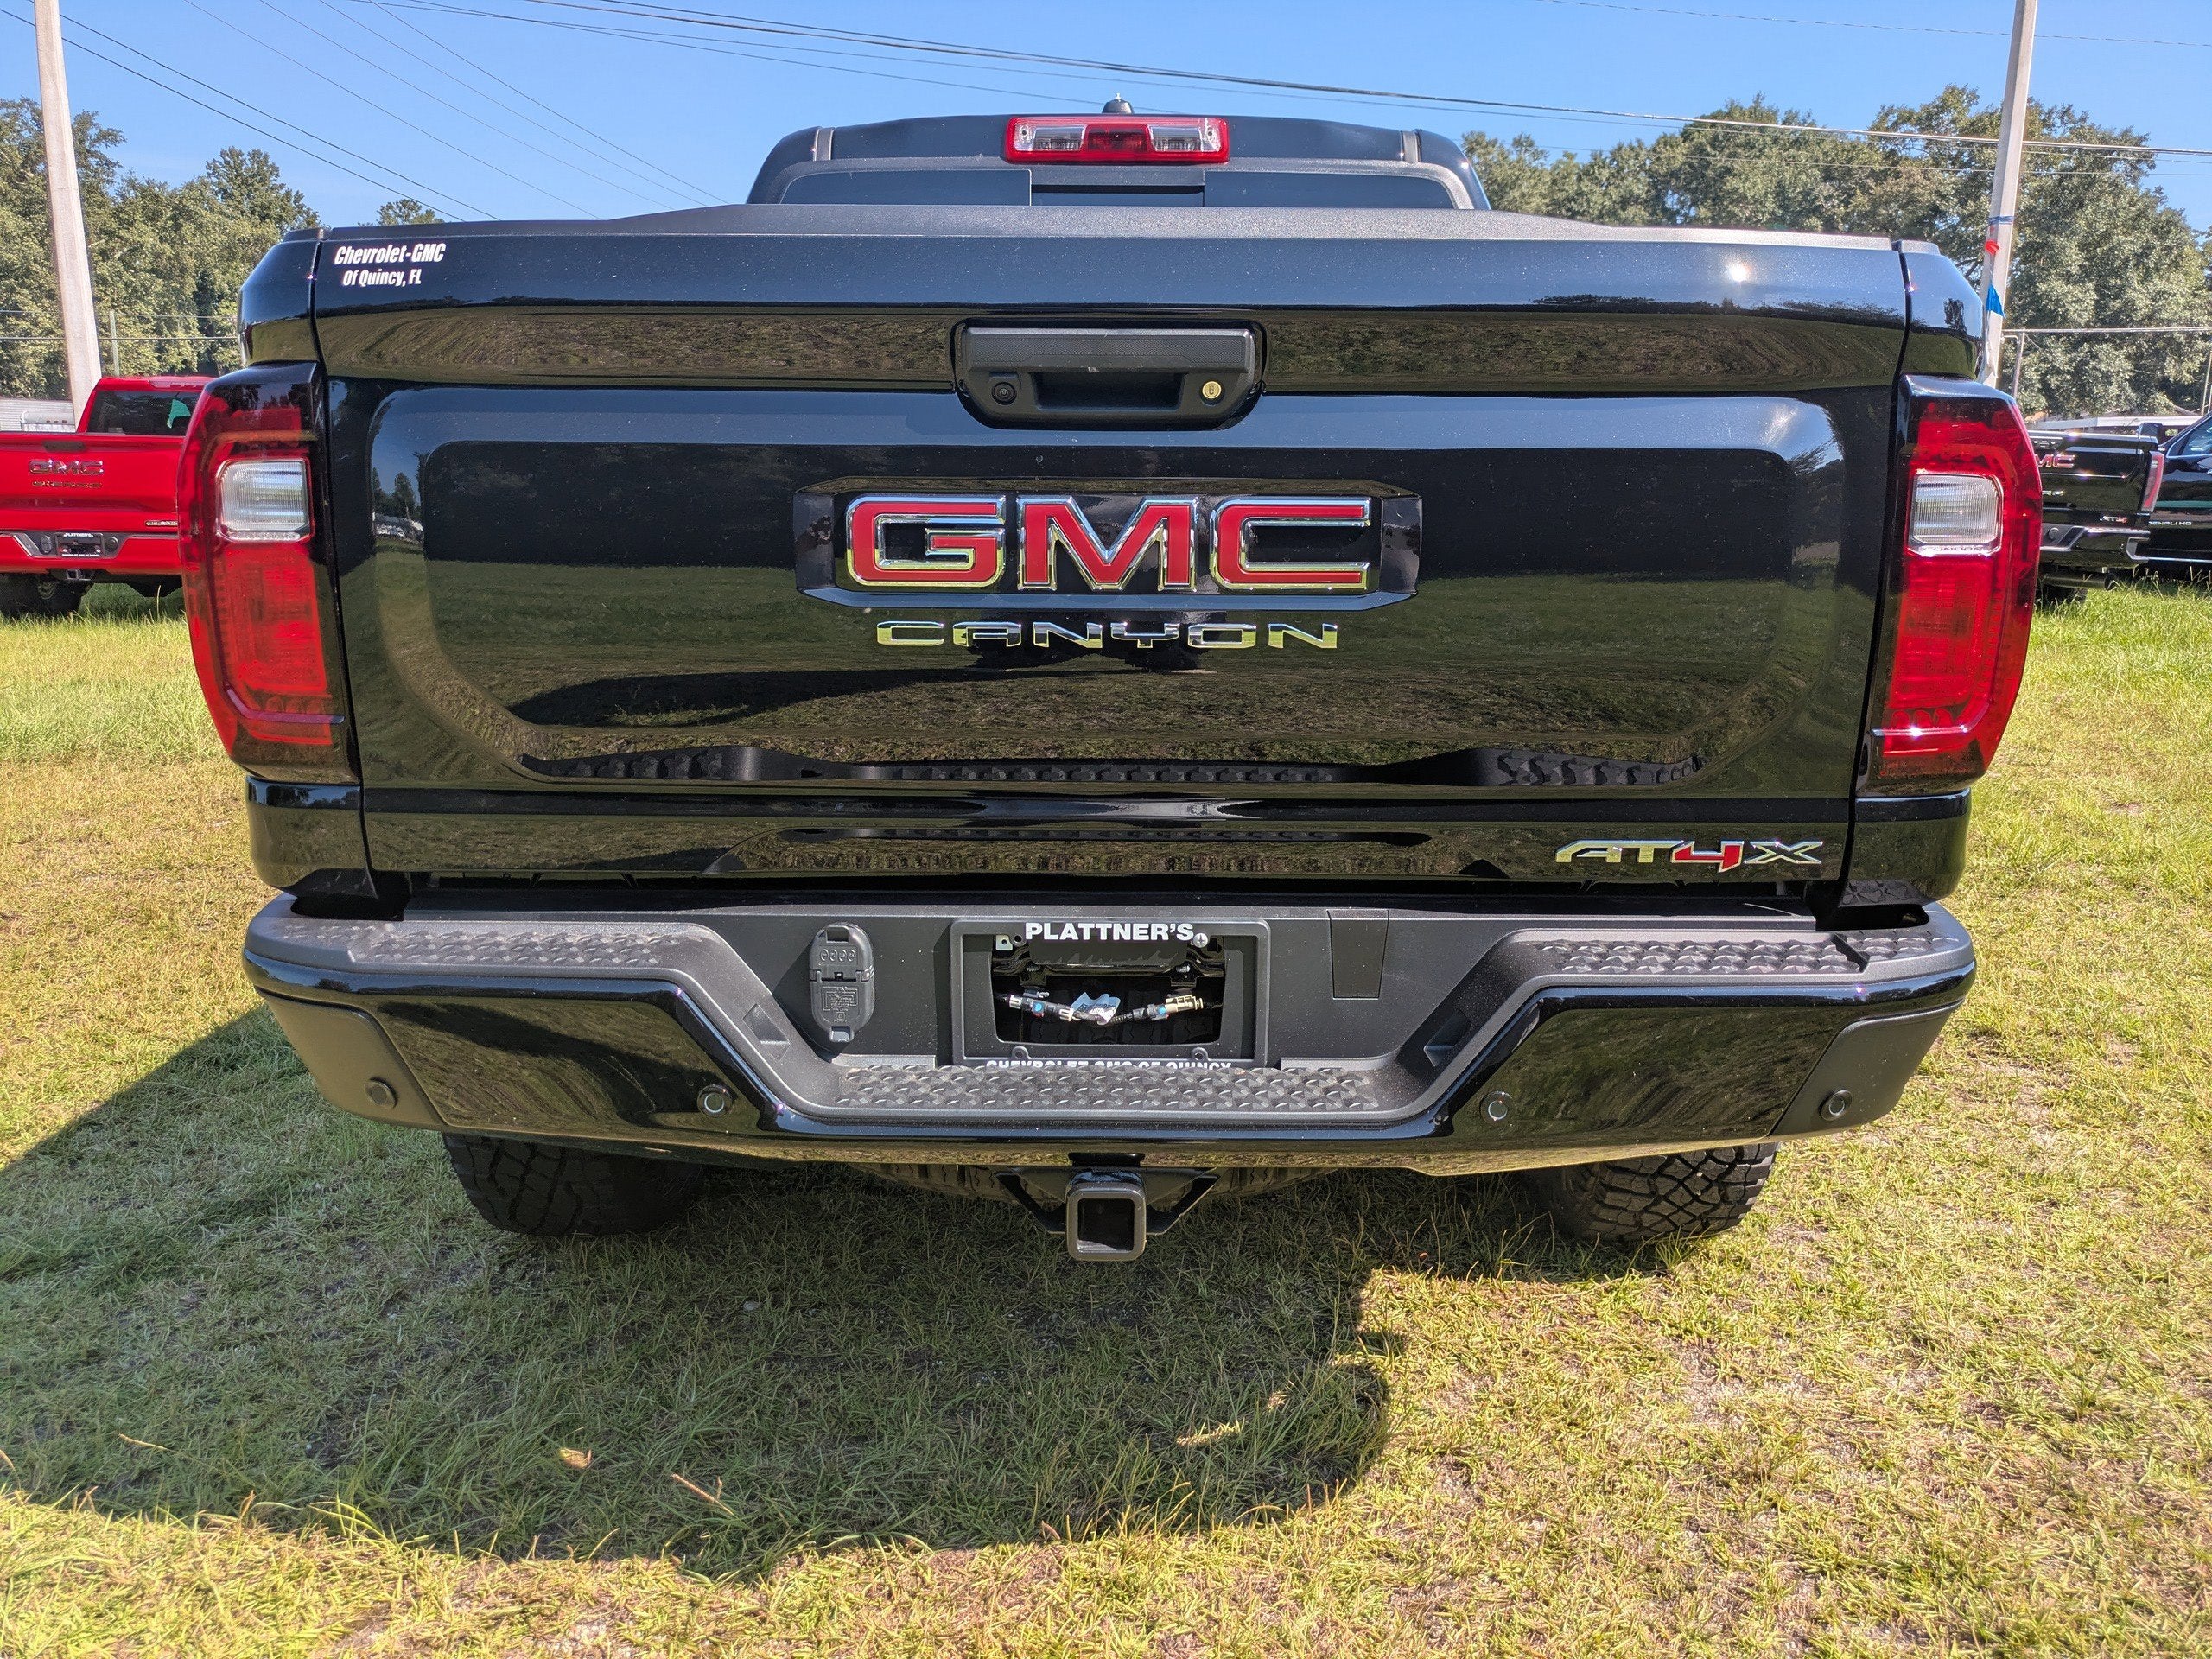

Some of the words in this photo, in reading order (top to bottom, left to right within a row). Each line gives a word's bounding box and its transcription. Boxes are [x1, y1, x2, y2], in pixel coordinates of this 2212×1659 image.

[334, 243, 446, 265] Chevrolet-GMC
[342, 270, 359, 286] Of
[359, 269, 406, 287] Quincy,
[409, 269, 423, 285] FL
[845, 495, 1372, 591] GMC
[876, 620, 1338, 650] CANYON
[1555, 839, 1824, 873] AT4X
[1025, 922, 1194, 942] PLATTNER'S
